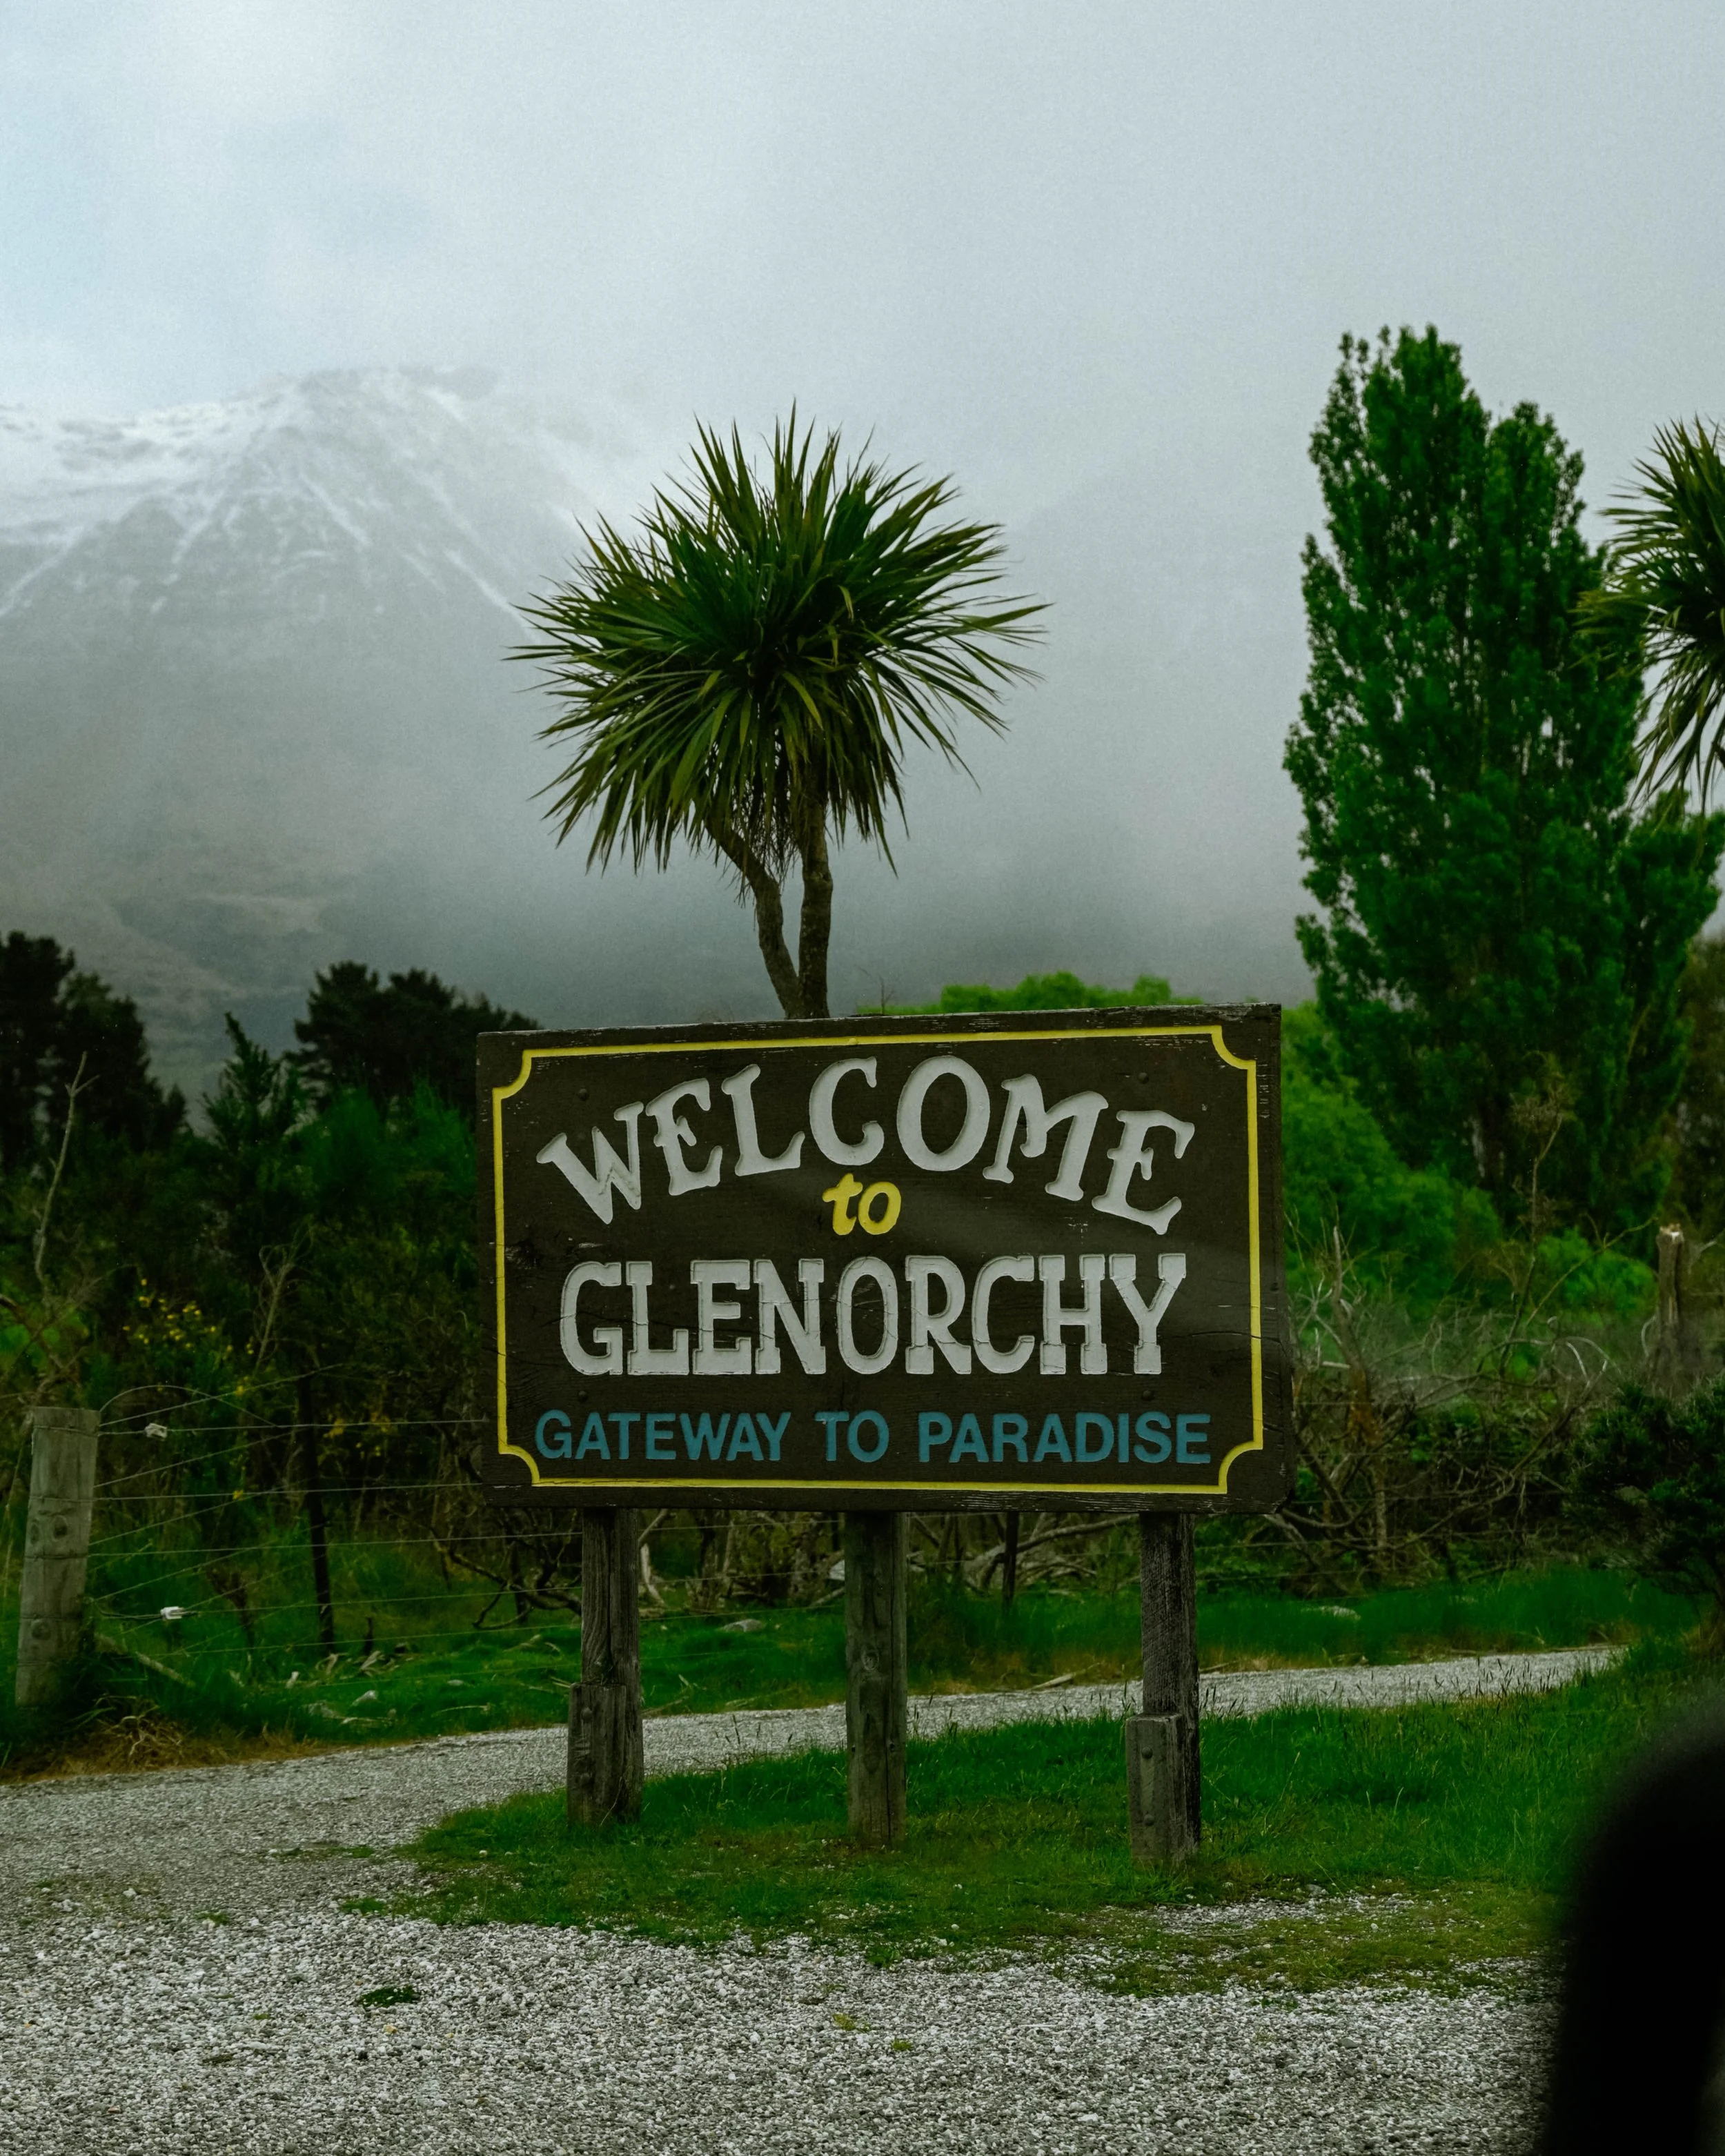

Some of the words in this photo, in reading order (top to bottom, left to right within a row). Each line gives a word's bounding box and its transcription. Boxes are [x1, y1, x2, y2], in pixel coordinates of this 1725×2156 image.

[536, 1055, 1195, 1236] WELCOME
[822, 1173, 902, 1236] to
[560, 1252, 1187, 1376] GLENORCHY
[535, 1410, 791, 1461] GATEWAY
[816, 1410, 890, 1463] TO
[918, 1412, 1212, 1464] PARADISE
